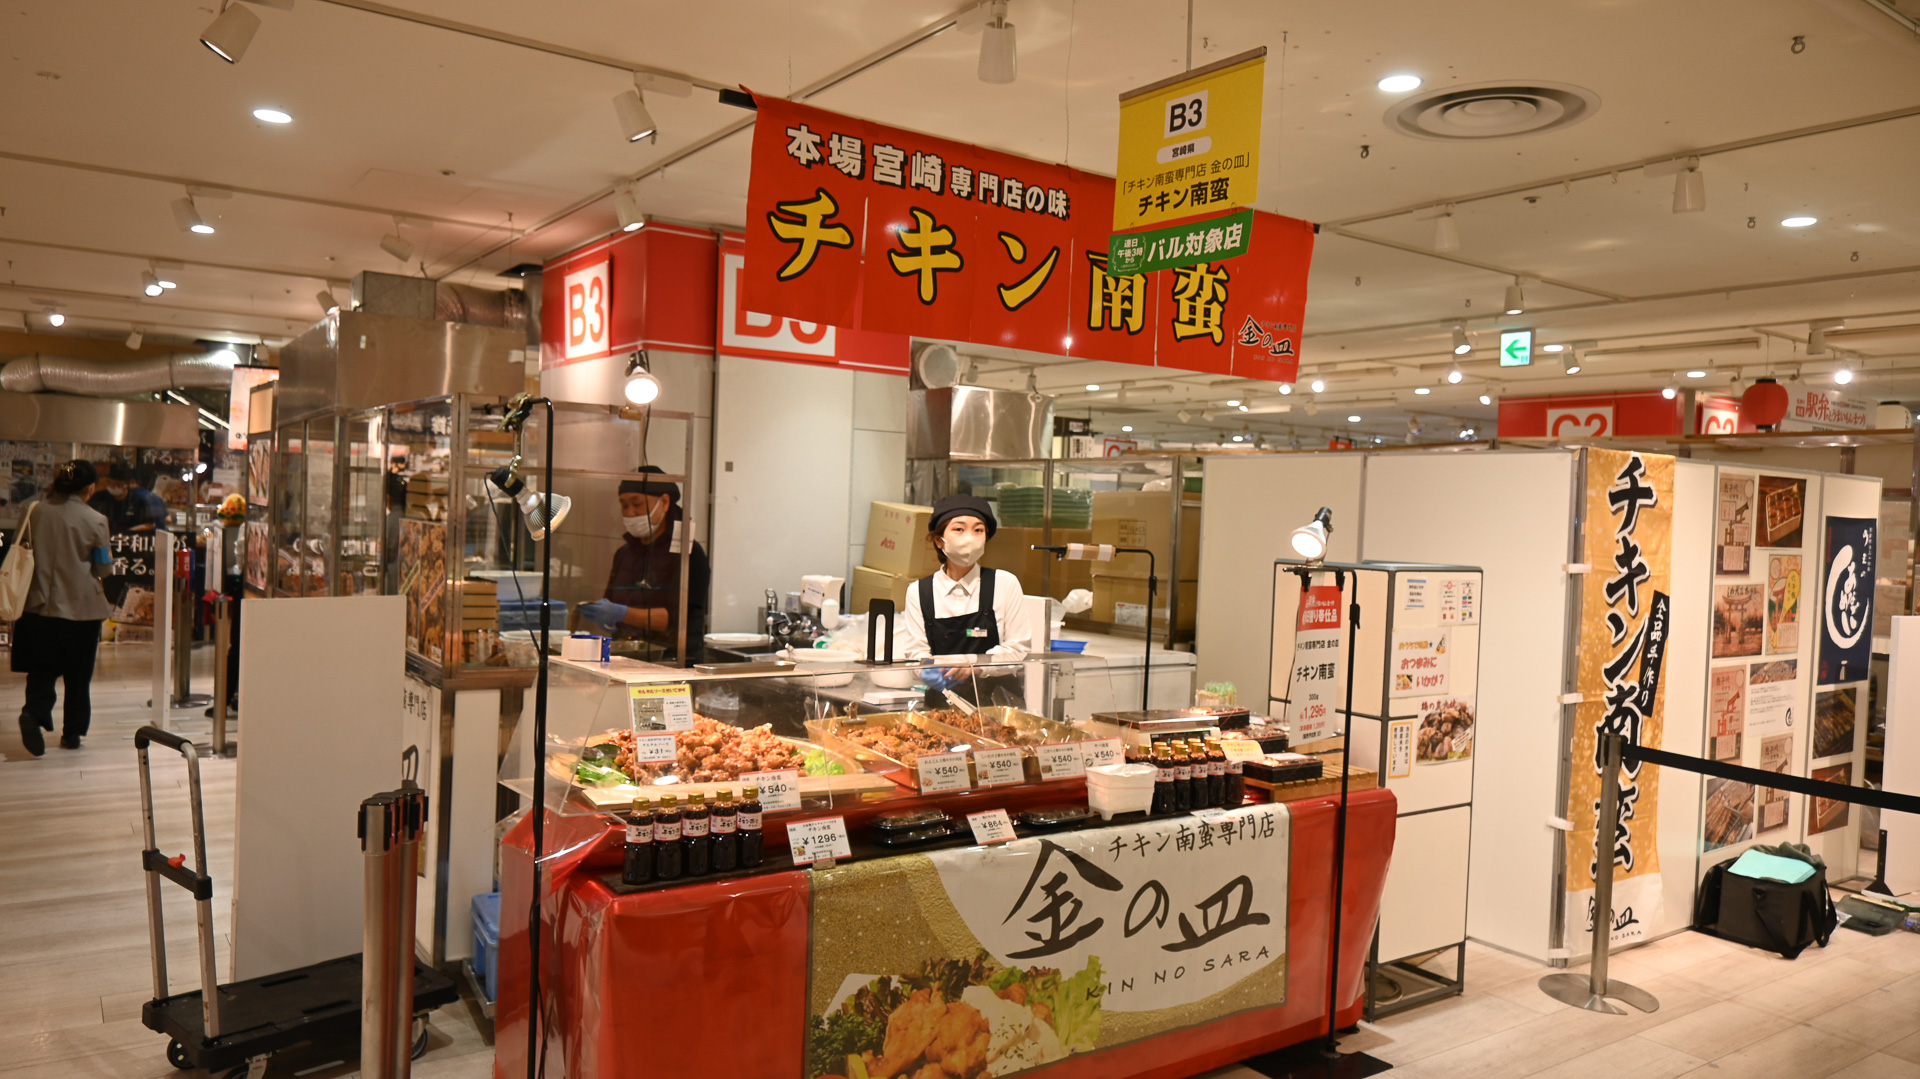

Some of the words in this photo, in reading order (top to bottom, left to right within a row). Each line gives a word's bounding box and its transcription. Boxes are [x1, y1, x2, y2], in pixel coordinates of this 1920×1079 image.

[1169, 98, 1203, 133] B3
[1171, 142, 1195, 159] 宮崎県
[786, 124, 1070, 220] 本場宮崎専門店の味
[1123, 163, 1207, 195] 「チキン南蛮専門店
[1210, 152, 1250, 174] 金の皿」
[1138, 177, 1230, 217] チキン南蛮
[1147, 222, 1243, 263] バル対象店
[766, 187, 1230, 346] チキン南蛮
[569, 276, 604, 347] B3
[1238, 315, 1294, 356] 金の皿
[111, 533, 187, 552] 宇和が
[1401, 657, 1437, 671] おつまみに
[1641, 598, 1667, 707] 全品手作り
[1296, 662, 1336, 683] チキン南蛮
[934, 766, 959, 775] ¥540
[989, 760, 1012, 768] ¥540
[1052, 755, 1072, 763] ¥540
[1094, 750, 1115, 758] ¥540
[759, 784, 787, 794] ¥540
[802, 833, 837, 846] ¥1296
[981, 820, 1003, 828] ¥864
[1108, 812, 1275, 862] チキン南蛮専門店
[1001, 838, 1270, 960] 金の皿
[1086, 977, 1134, 1001] KIN
[1154, 965, 1186, 984] NO
[1203, 946, 1270, 972] SARA
